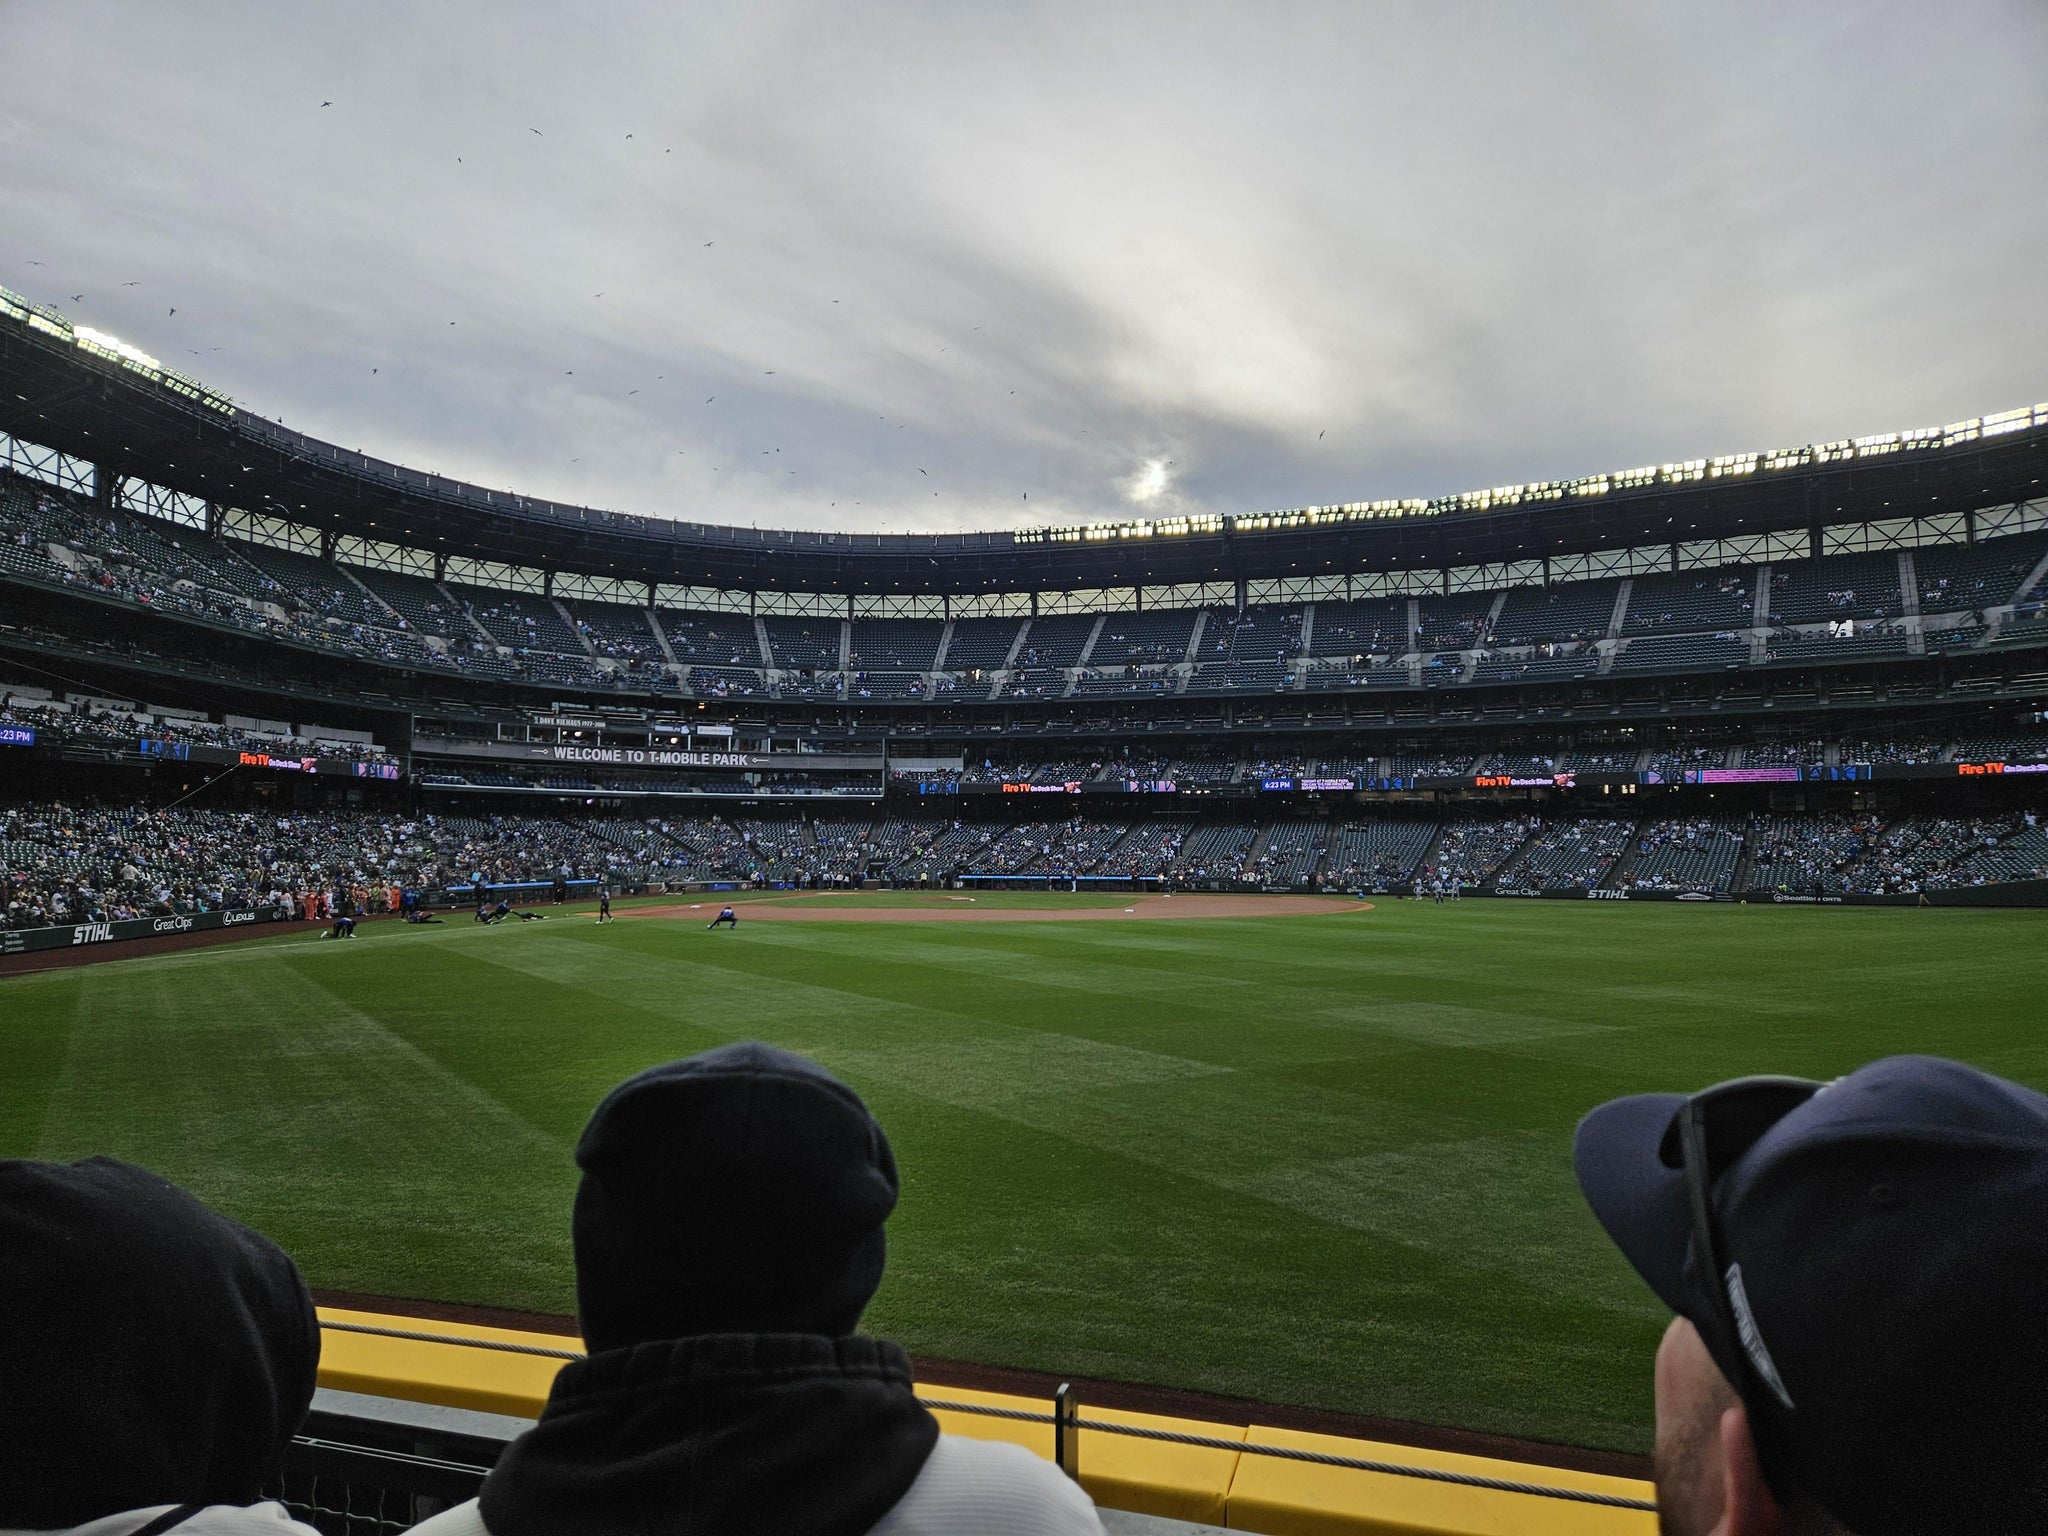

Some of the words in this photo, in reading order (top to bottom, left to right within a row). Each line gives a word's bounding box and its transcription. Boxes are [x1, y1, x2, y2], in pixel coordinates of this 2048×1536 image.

[540, 717, 554, 725] DAVE
[16, 731, 30, 741] PM
[240, 753, 257, 764] Fire
[257, 755, 269, 766] TV
[554, 746, 621, 762] WELCOME
[627, 751, 644, 763] TO
[649, 751, 709, 765] T-MOBILE
[712, 754, 748, 766] PARK
[1959, 764, 1984, 774] Fire
[1984, 763, 2005, 773] TV
[2004, 765, 2016, 773] On
[1265, 781, 1279, 789] 6:23
[1476, 777, 1496, 786] Fire
[1496, 776, 1511, 785] TV
[1003, 784, 1018, 792] Fire
[1019, 783, 1030, 792] TV
[1495, 888, 1520, 896] Great
[1521, 888, 1541, 896] Clips
[1587, 890, 1630, 899] STIHL
[231, 912, 255, 922] LEXUS
[154, 919, 174, 931] Great
[175, 916, 193, 931] Clips
[73, 924, 113, 944] STIHL
